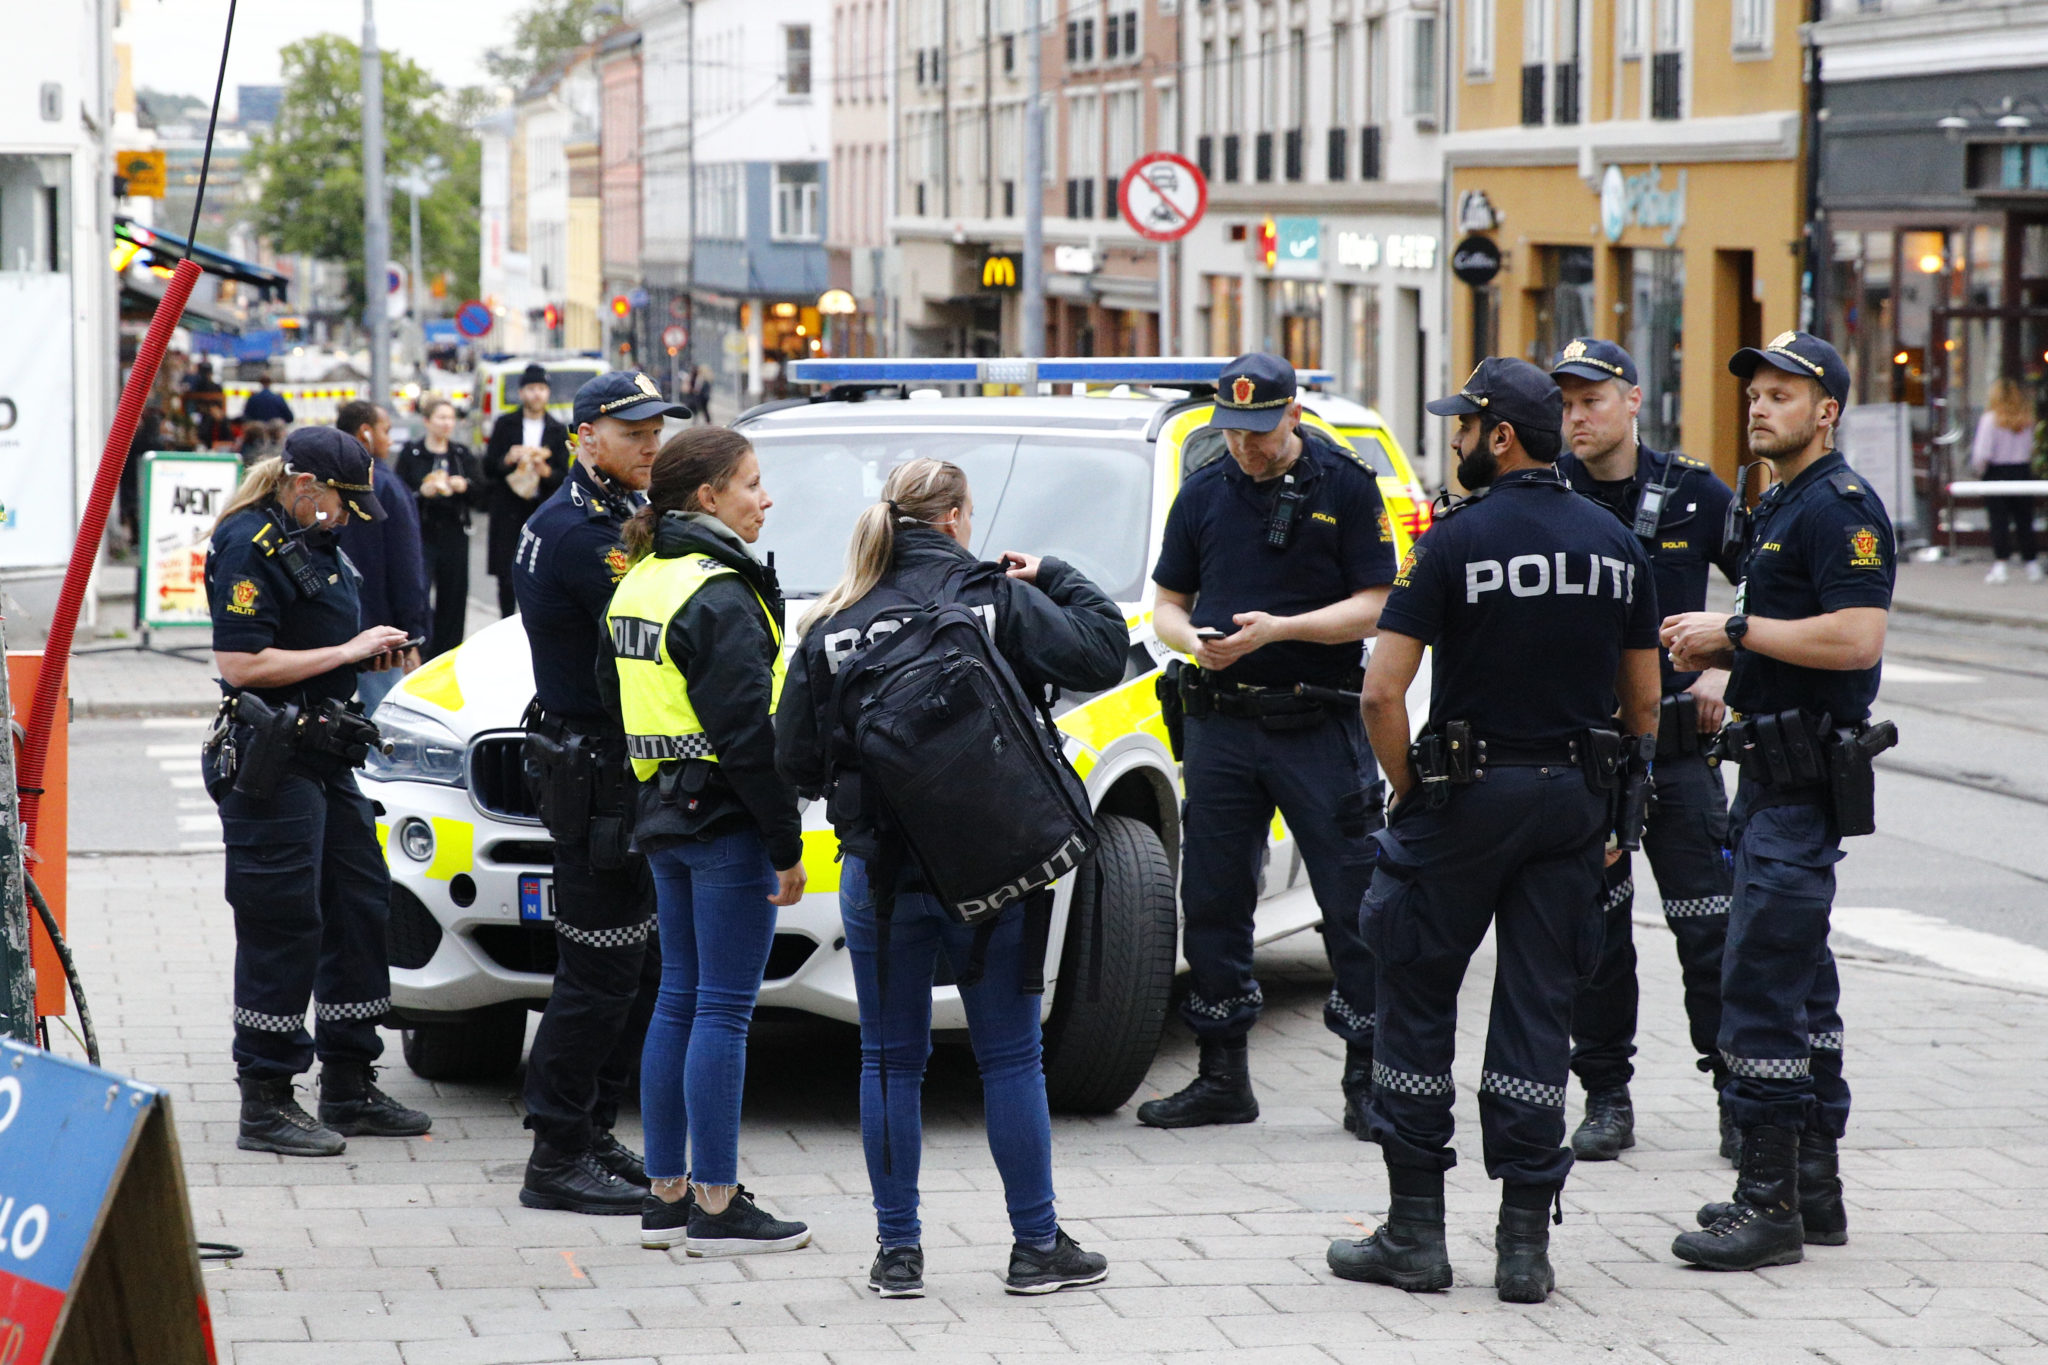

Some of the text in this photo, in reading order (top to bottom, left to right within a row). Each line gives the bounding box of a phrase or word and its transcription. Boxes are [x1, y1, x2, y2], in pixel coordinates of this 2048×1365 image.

[1312, 512, 1336, 525] POLITI
[1661, 541, 1688, 549] POLITI
[1851, 558, 1882, 566] POLITI
[1465, 552, 1635, 604] POLITI
[227, 605, 256, 616] POLITI
[956, 833, 1086, 922] POLITI
[527, 904, 537, 914] N
